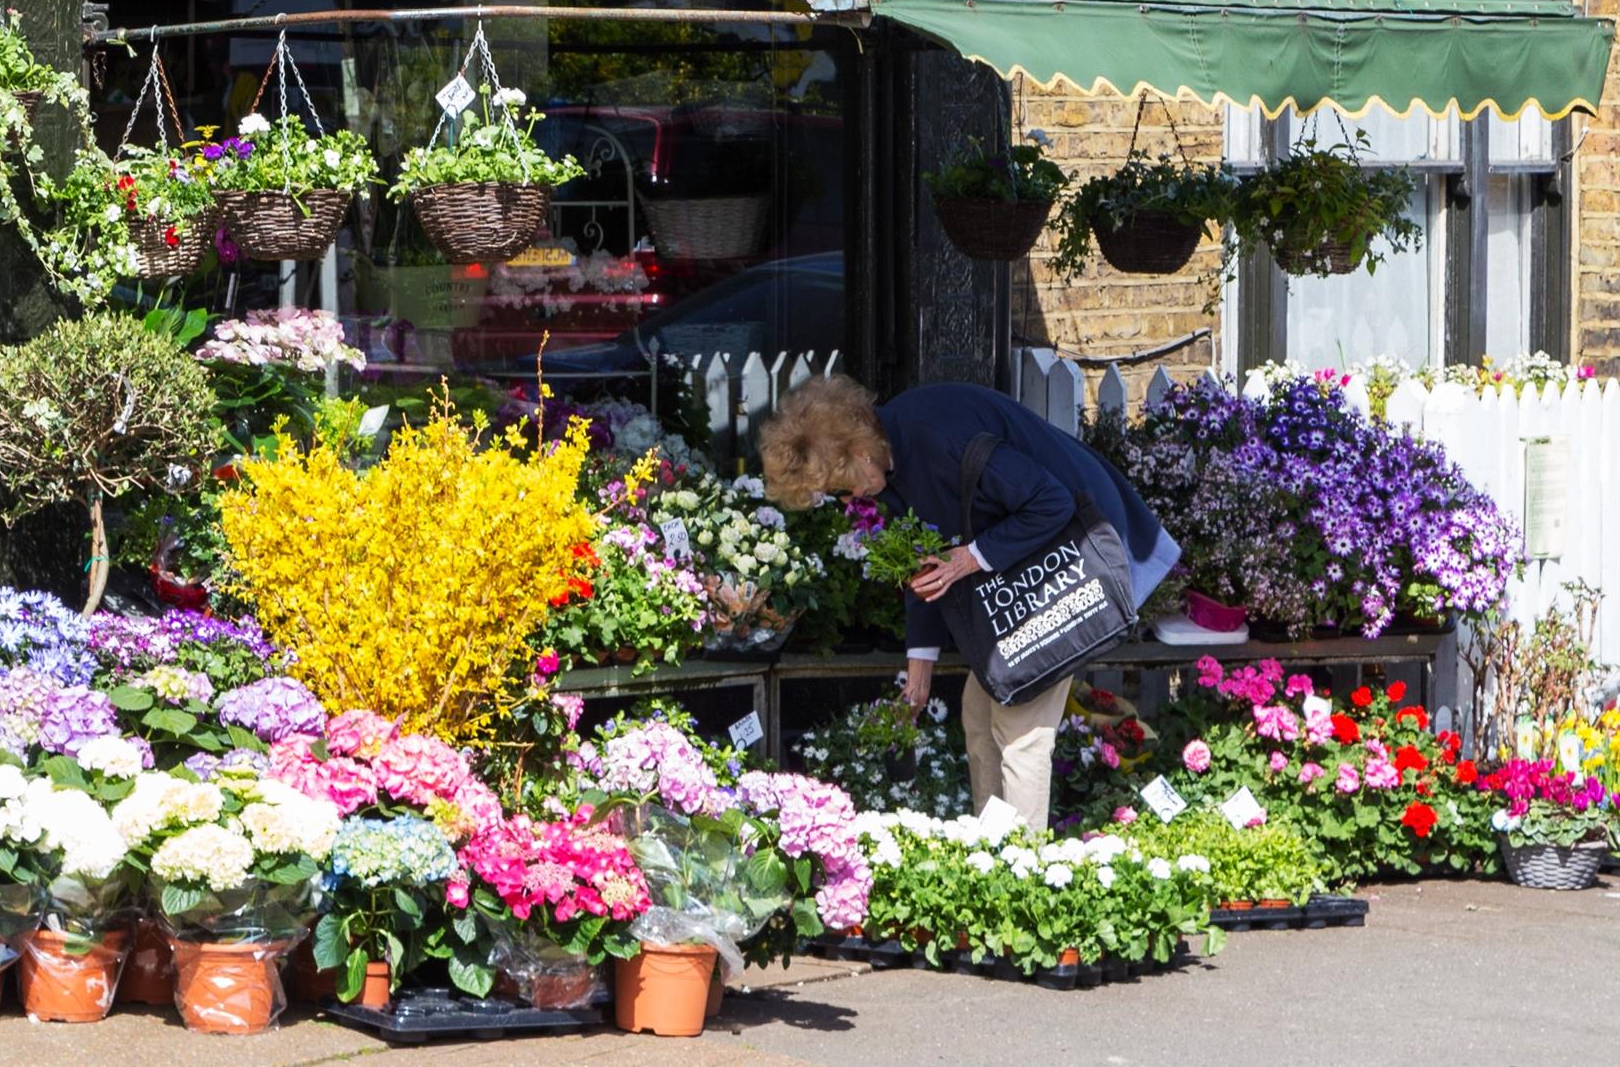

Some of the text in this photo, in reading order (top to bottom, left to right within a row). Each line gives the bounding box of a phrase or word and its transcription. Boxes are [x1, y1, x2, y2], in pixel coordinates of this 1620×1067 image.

[975, 573, 1005, 598] THE
[983, 540, 1081, 618] LONDON
[991, 558, 1087, 636] LIBRARY
